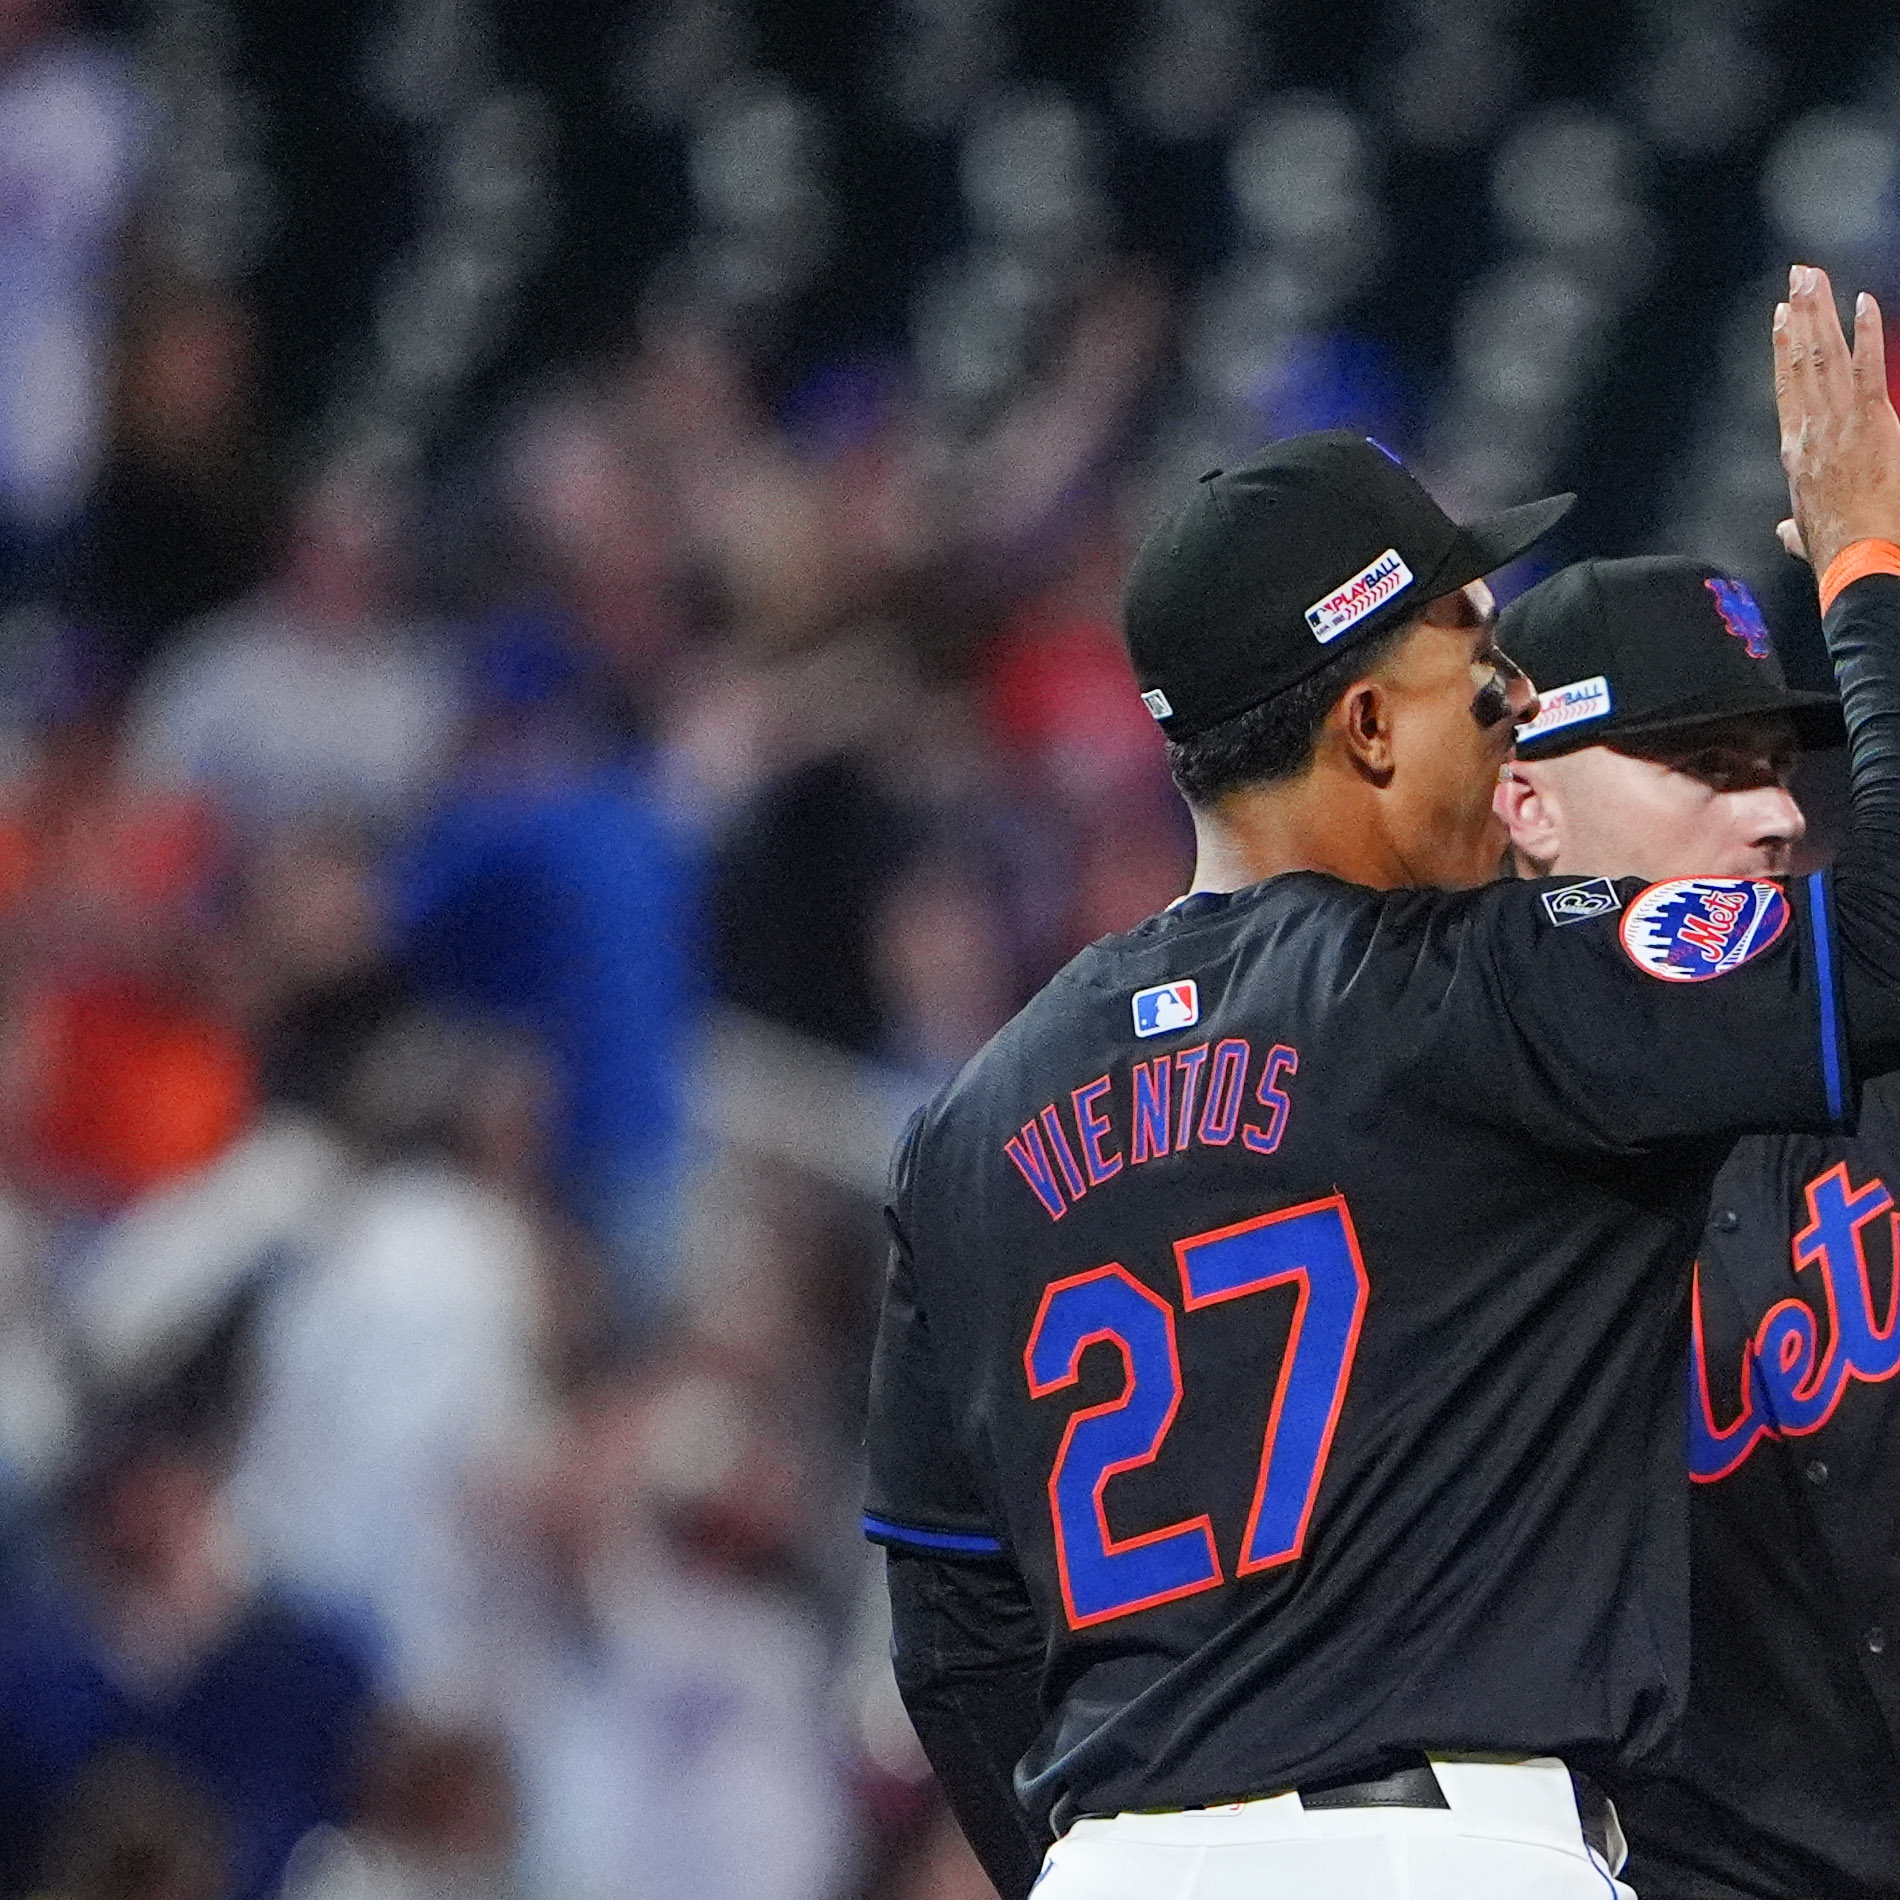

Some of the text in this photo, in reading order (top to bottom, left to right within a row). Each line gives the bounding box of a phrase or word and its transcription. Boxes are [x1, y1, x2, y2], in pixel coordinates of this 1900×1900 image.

[1677, 890, 1749, 963] Mets
[1004, 1038, 1298, 1221] VIENTOS
[1023, 1192, 1370, 1631] 27
